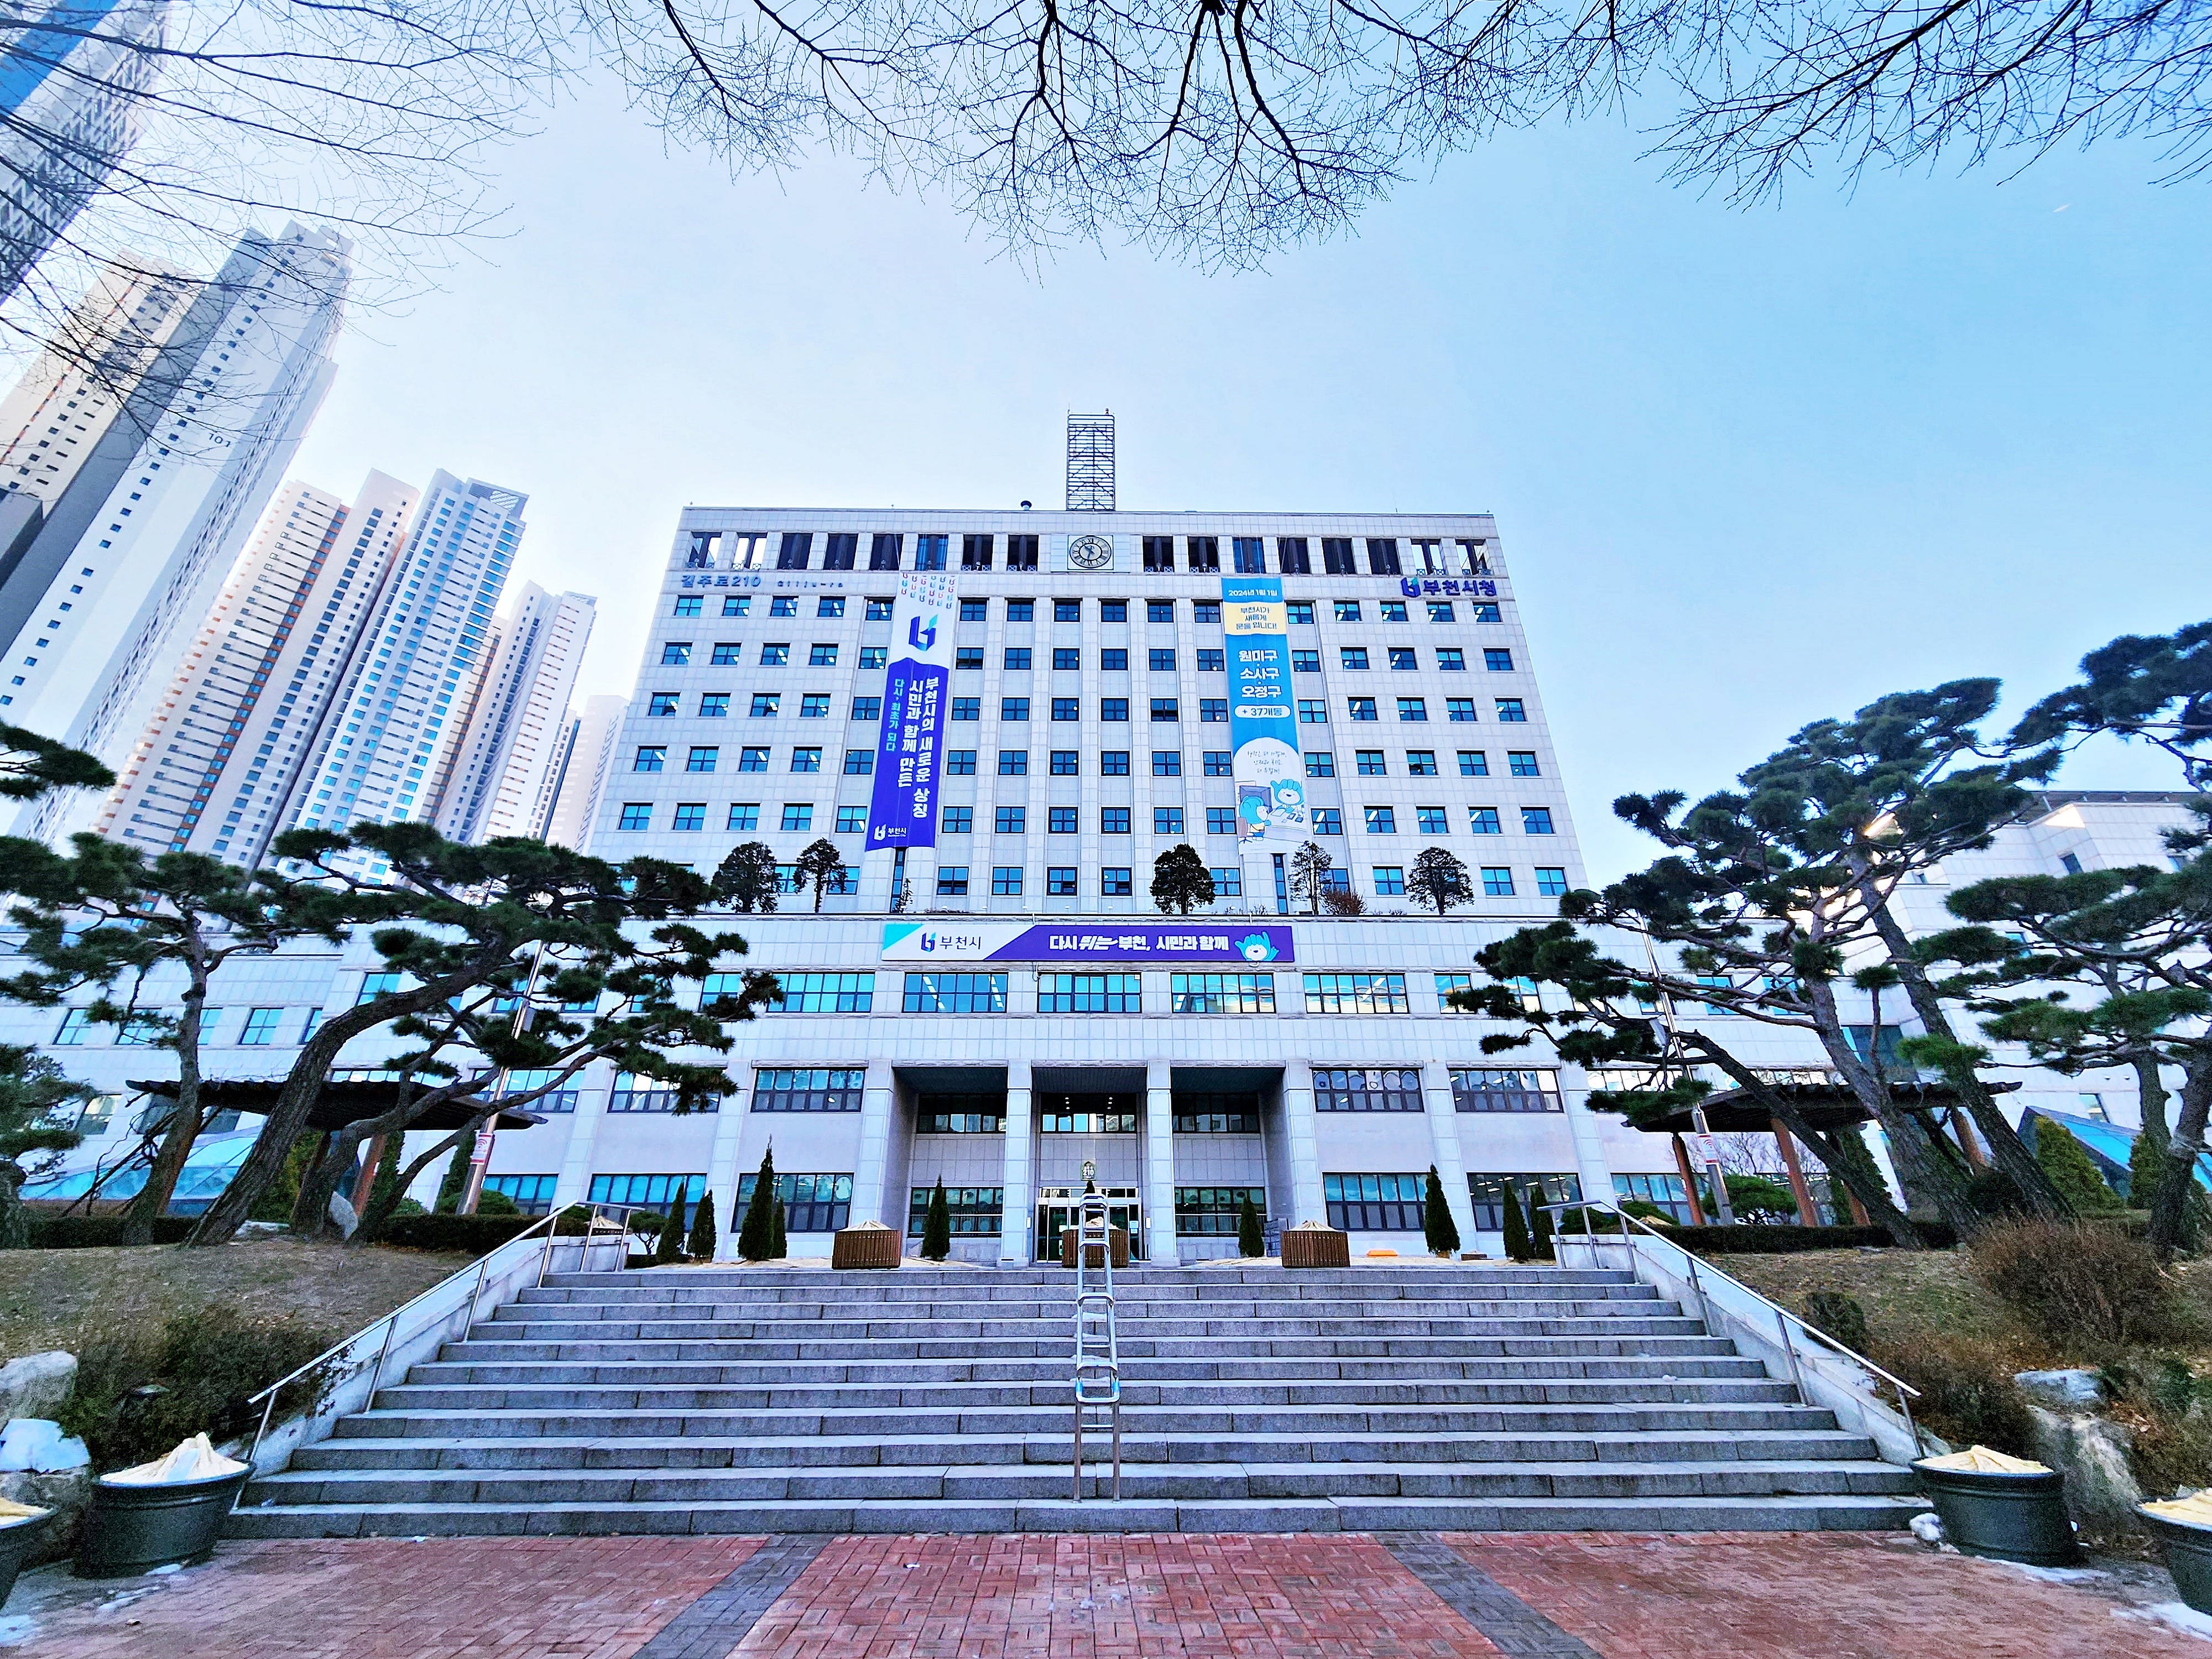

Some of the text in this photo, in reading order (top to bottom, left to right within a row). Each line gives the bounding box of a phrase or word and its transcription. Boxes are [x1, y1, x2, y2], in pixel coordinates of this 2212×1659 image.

[208, 432, 231, 447] 101
[1423, 580, 1496, 596] 부천시청
[1238, 649, 1278, 662] 원미구
[1240, 667, 1280, 680] 소사구
[1241, 685, 1282, 698] 오정구
[889, 702, 900, 729] 최초가
[898, 680, 924, 787] 시민과 함께 만든
[885, 732, 897, 752] 되다
[912, 676, 938, 818] 부천시의 새로운 상징
[940, 936, 982, 950] 부천시
[1048, 935, 1230, 951] 다시 뛰는 부천, 시민과 함께
